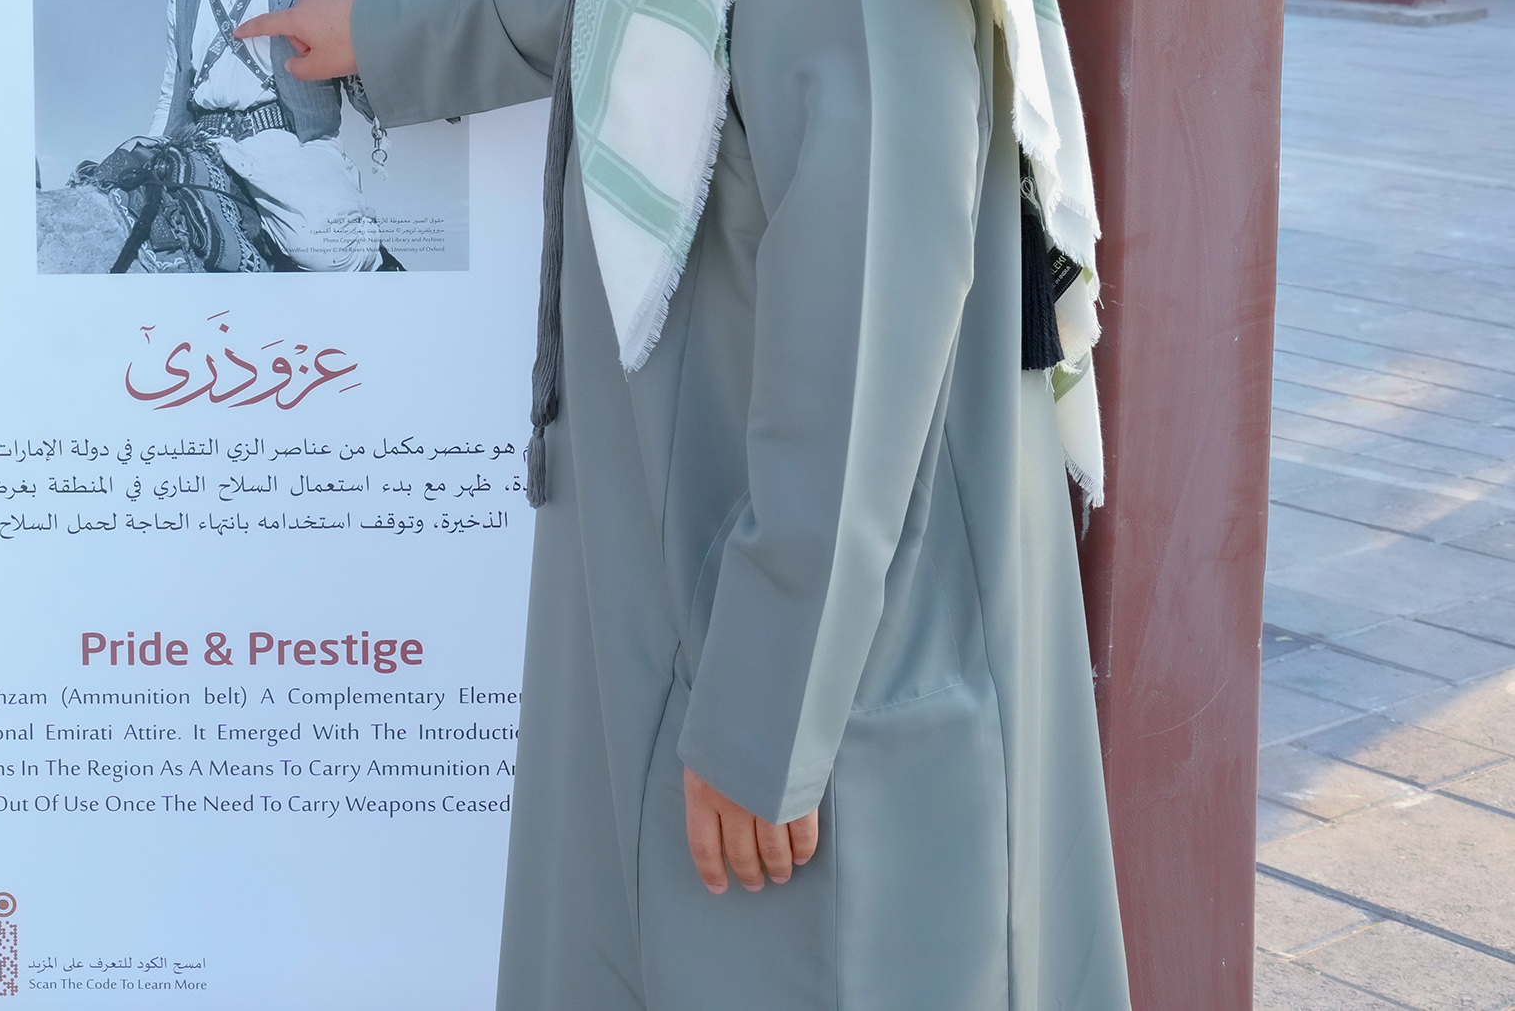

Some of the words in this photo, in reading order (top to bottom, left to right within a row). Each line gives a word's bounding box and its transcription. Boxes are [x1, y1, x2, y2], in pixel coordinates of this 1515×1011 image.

[70, 439, 110, 461] دولة
[116, 439, 133, 466] في
[139, 438, 219, 466] التقليدي
[226, 438, 265, 463] الزي
[267, 438, 332, 461] عناصر
[339, 445, 366, 461] من
[373, 436, 425, 460] مكمل
[426, 442, 485, 461] عنصر
[487, 443, 516, 461] هو
[48, 475, 114, 495] المنطقة
[125, 476, 142, 503] في
[152, 475, 206, 501] الناري
[217, 475, 278, 502] السلاح
[289, 475, 370, 497] استعمال
[382, 480, 413, 496] بدء
[423, 482, 447, 501] مع
[452, 474, 492, 498] ظهر
[66, 512, 118, 535] لحمل
[125, 512, 190, 534] الحاجة
[198, 512, 250, 536] بانتهاء
[257, 512, 351, 530] استخدامه
[359, 512, 426, 535] وتوقف
[433, 511, 508, 534] الذخيرة،
[81, 631, 189, 667] Pride
[203, 631, 235, 667] &
[248, 630, 424, 675] Prestige
[61, 685, 190, 709] (Ammunition
[204, 685, 247, 709] belt)
[259, 687, 276, 705] A
[287, 685, 446, 710] Complementary
[459, 685, 521, 704] Eleme
[45, 723, 113, 741] Emirati
[123, 723, 182, 741] Attire.
[193, 723, 207, 741] It
[217, 721, 301, 747] Emerged
[312, 721, 360, 741] With
[370, 721, 407, 740] The
[419, 721, 518, 740] Introducti
[21, 759, 39, 777] In
[44, 758, 81, 777] The
[87, 759, 154, 784] Region
[159, 759, 184, 777] As
[188, 759, 204, 777] A
[208, 759, 275, 777] Means
[279, 759, 303, 777] To
[308, 759, 361, 783] Carry
[366, 759, 490, 777] Ammunition
[34, 793, 60, 812] Of
[64, 795, 100, 812] Use
[105, 795, 156, 812] Once
[160, 793, 198, 812] The
[203, 793, 254, 812] Need
[259, 795, 282, 812] To
[287, 795, 340, 819] Carry
[344, 795, 437, 819] Weapons
[441, 793, 511, 812] Ceased
[27, 956, 58, 973] المزيد
[62, 957, 85, 973] على
[88, 956, 133, 973] للتعرف
[136, 956, 168, 973] الكود
[172, 956, 207, 973] امسح
[28, 978, 58, 990] Scan
[60, 977, 83, 990] The
[86, 978, 116, 990] Code
[119, 978, 135, 990] To
[137, 978, 172, 990] Learn
[174, 978, 208, 990] More
